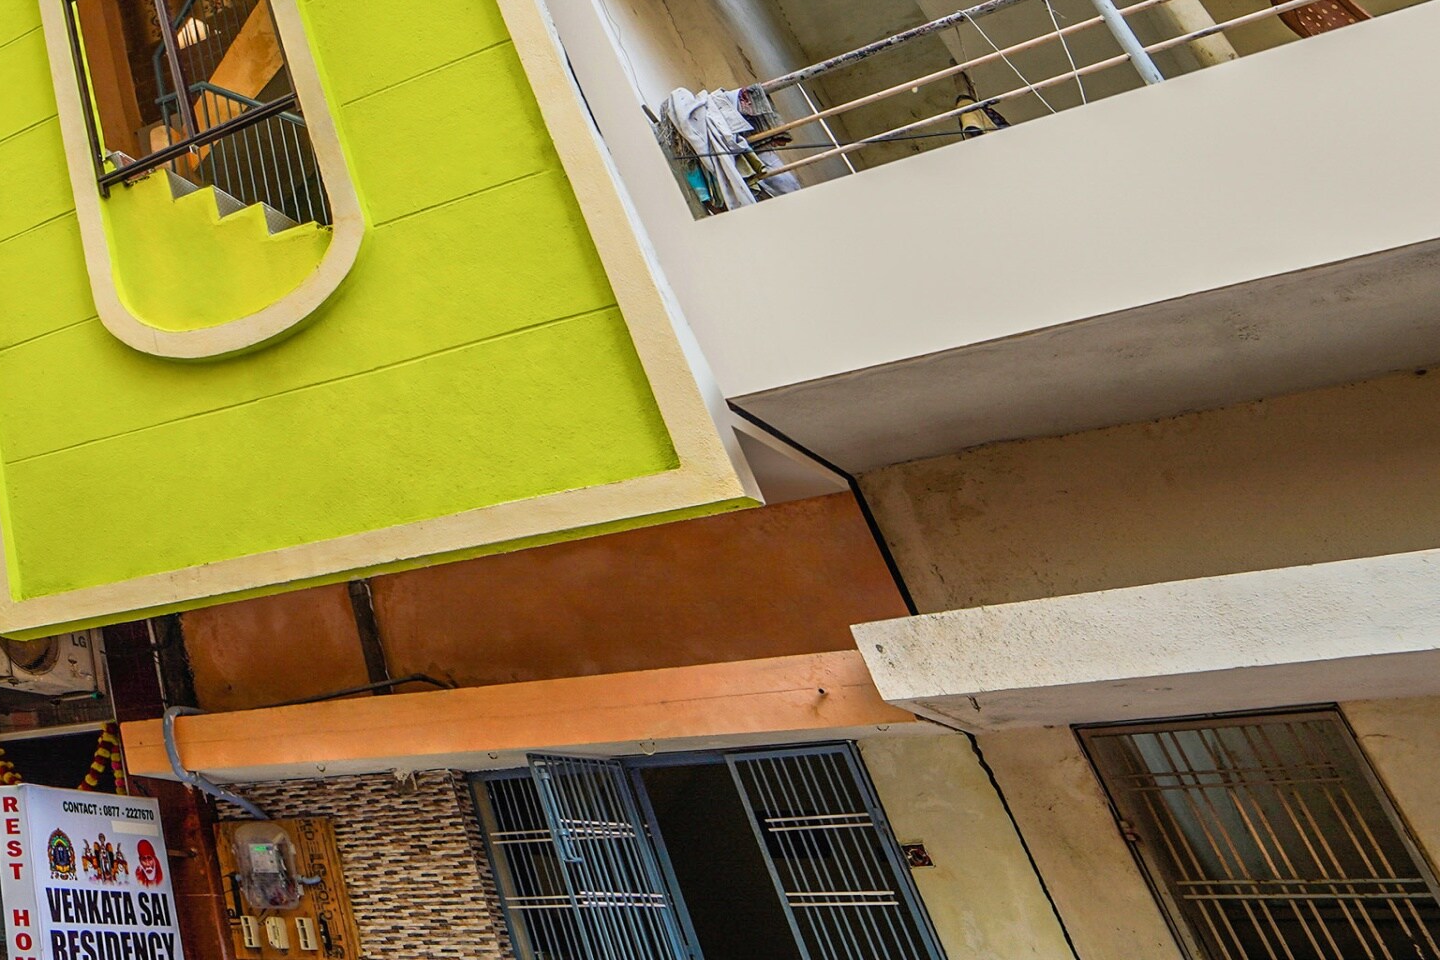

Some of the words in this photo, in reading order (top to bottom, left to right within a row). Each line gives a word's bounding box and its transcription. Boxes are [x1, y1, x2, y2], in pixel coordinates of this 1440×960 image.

[71, 634, 88, 649] LG
[62, 801, 97, 815] CONTACT
[103, 805, 119, 817] 0877
[125, 807, 154, 820] 2227670
[2, 797, 23, 880] REST
[45, 887, 138, 925] VENKATA
[138, 891, 172, 926] SAI
[50, 929, 175, 960] RESIDENCY
